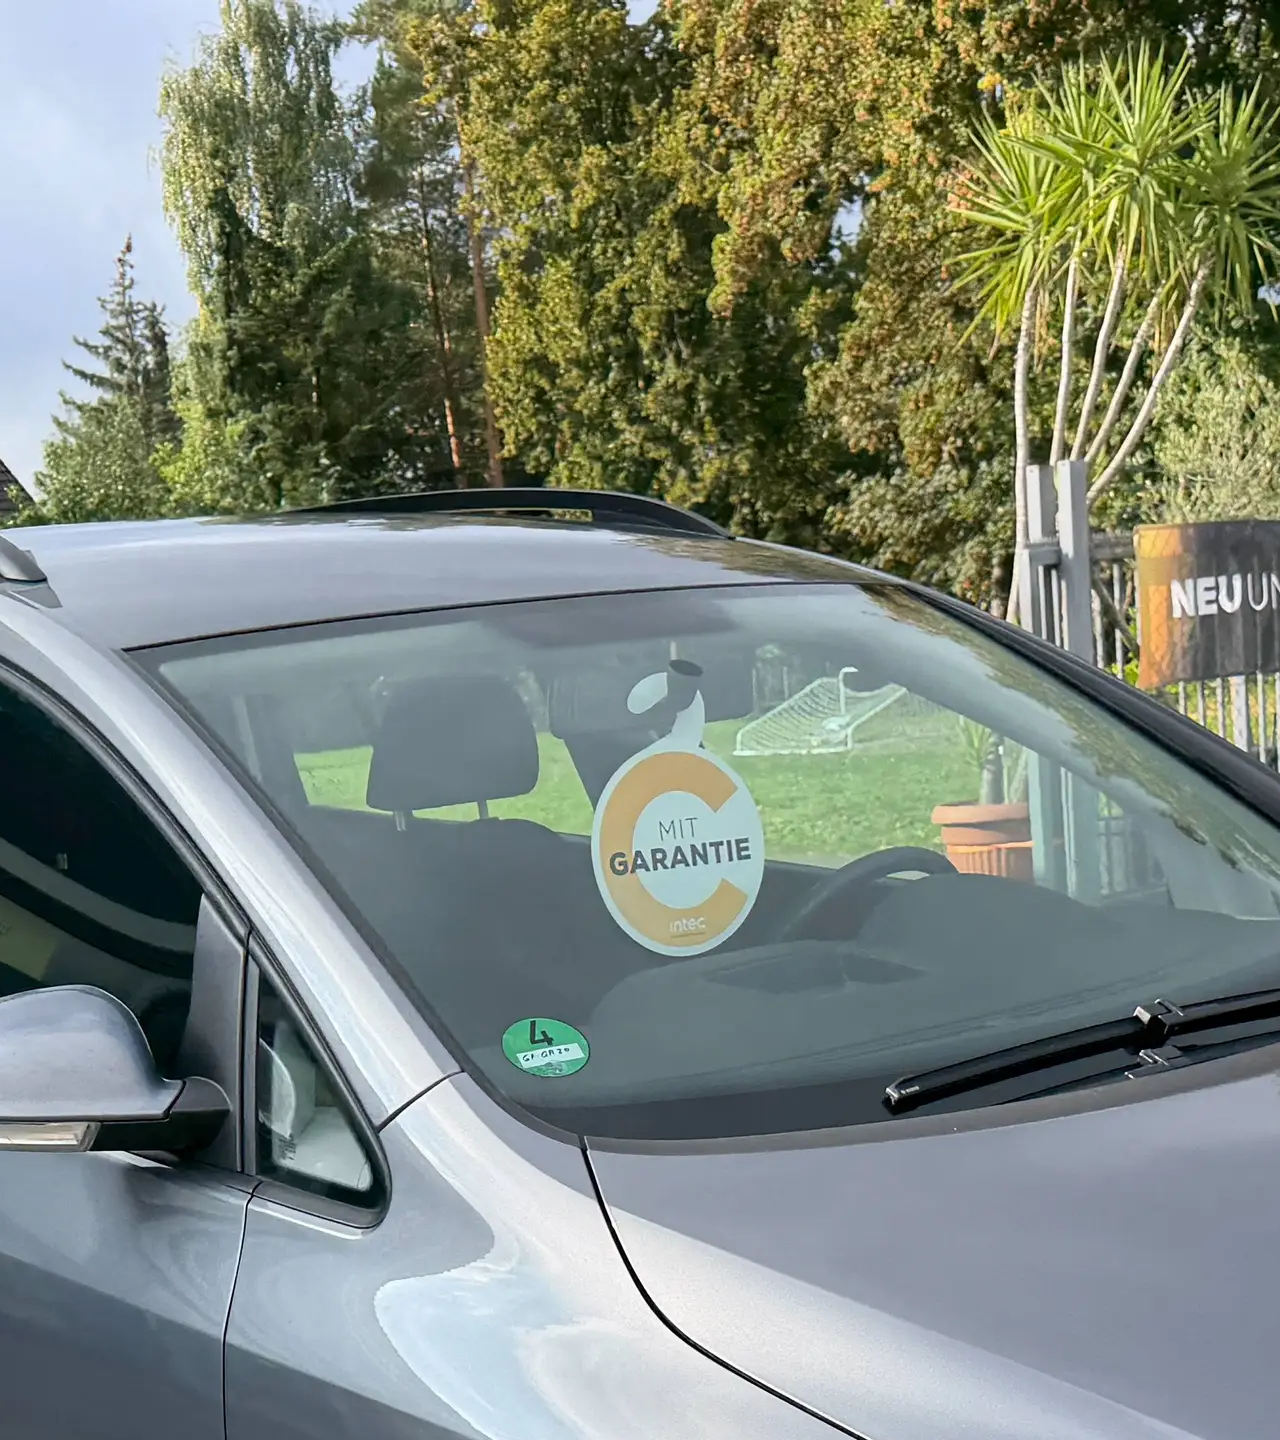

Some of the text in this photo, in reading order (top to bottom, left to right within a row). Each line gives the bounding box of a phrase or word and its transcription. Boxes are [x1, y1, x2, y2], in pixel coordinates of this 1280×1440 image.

[658, 817, 698, 841] MIT
[609, 837, 752, 876] GARANTIE
[669, 916, 706, 933] intec
[529, 1019, 554, 1045] 4
